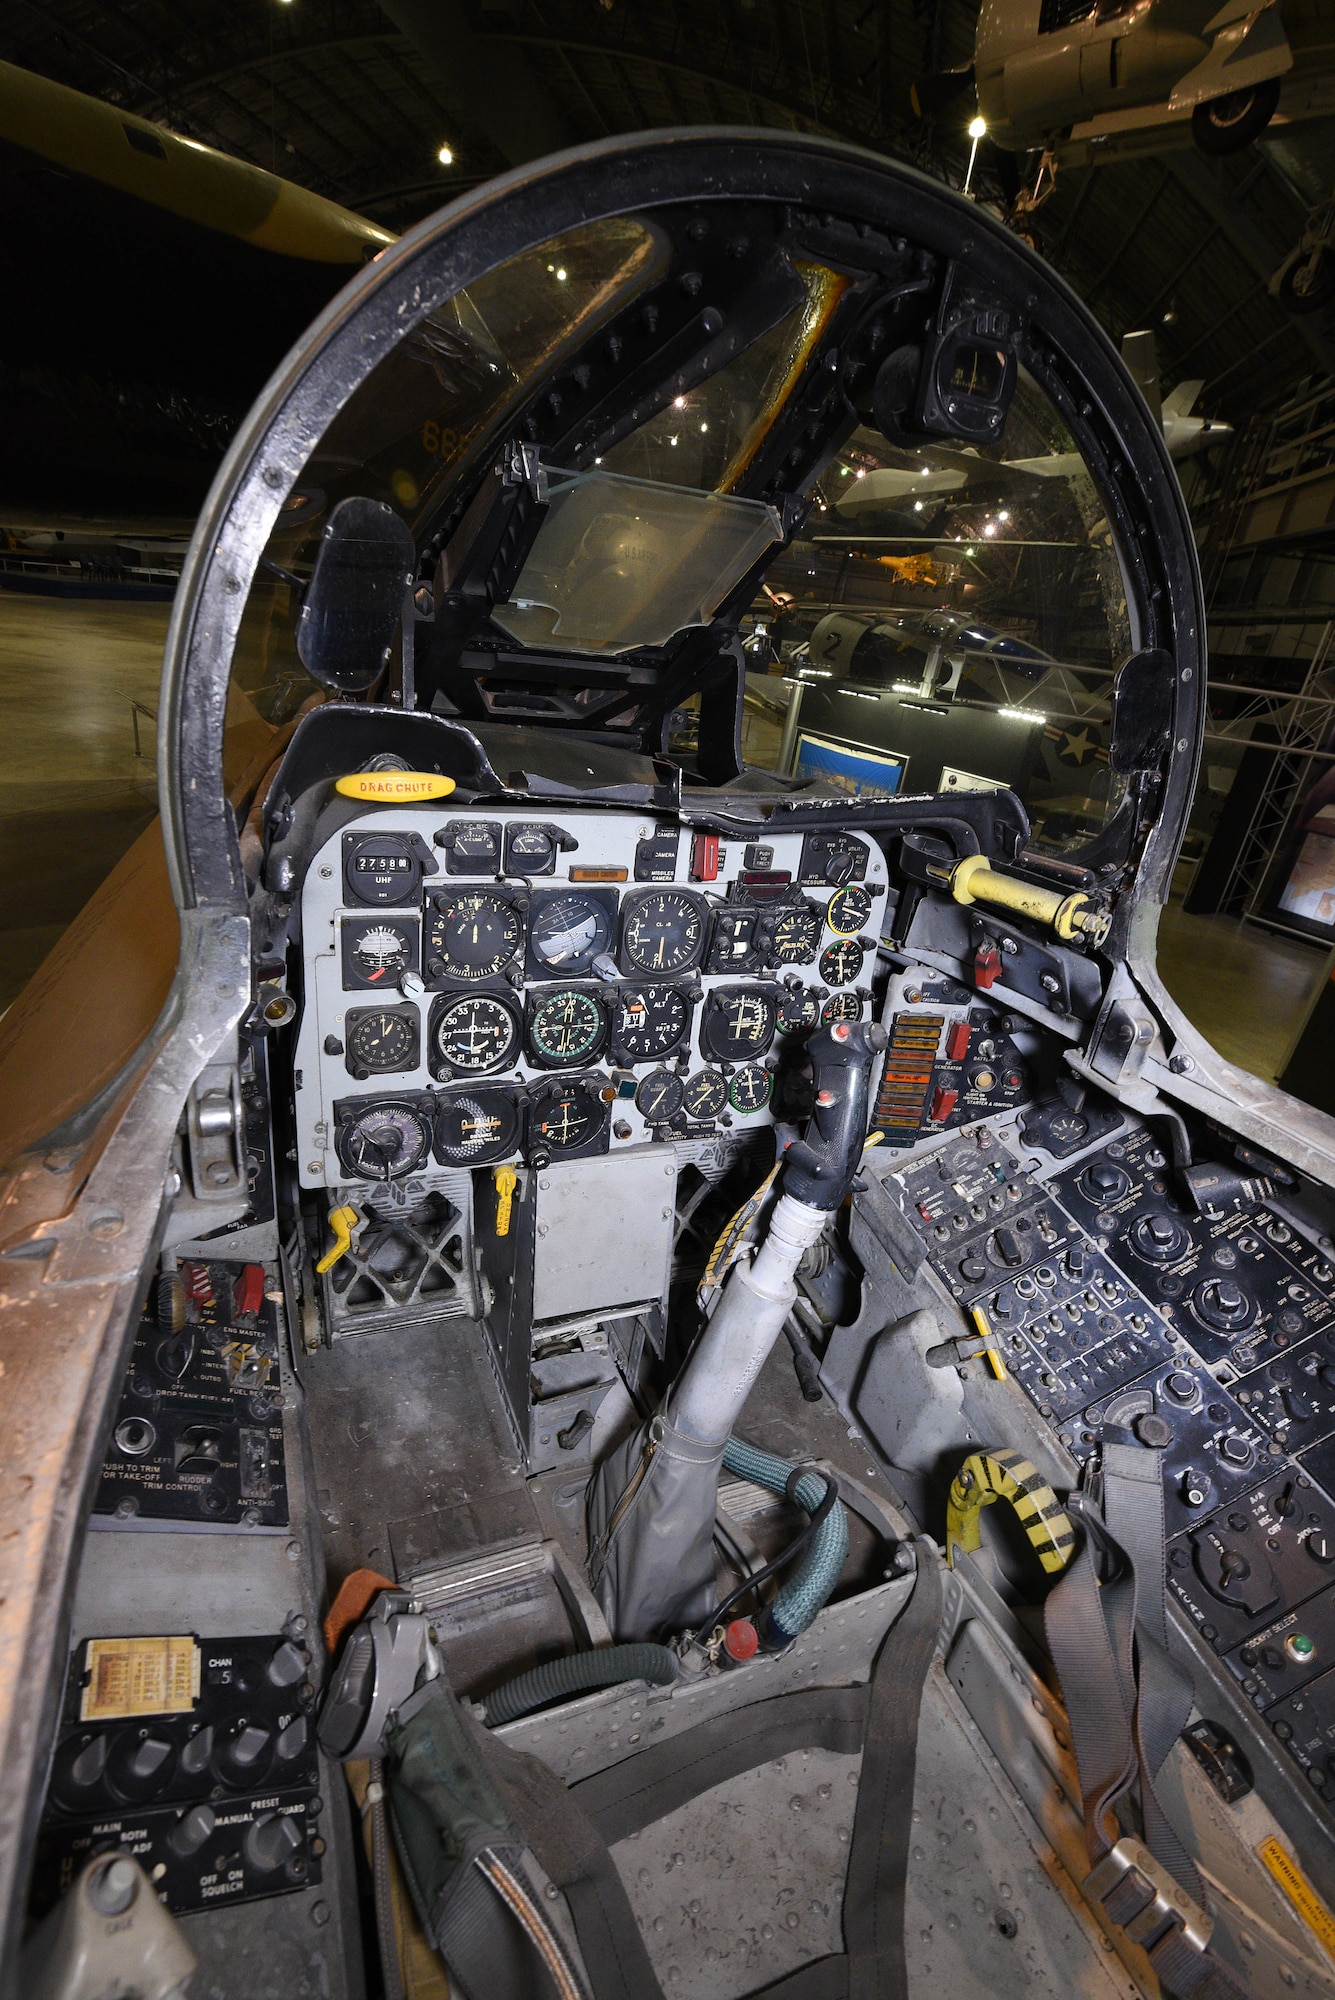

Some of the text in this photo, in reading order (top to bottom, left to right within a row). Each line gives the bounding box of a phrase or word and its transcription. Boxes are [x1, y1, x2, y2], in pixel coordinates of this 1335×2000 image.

[822, 632, 842, 660] 2
[360, 782, 433, 792] DRAG CHUTE
[375, 876, 392, 884] UHF
[458, 901, 464, 909] 8
[658, 903, 665, 912] 2
[447, 909, 453, 918] 7
[678, 909, 684, 917] 4
[438, 921, 445, 929] 6
[686, 929, 691, 937] 6
[443, 953, 450, 962] 4
[494, 955, 500, 963] 2
[654, 953, 659, 962] 2
[650, 990, 655, 998] 0
[557, 999, 565, 1007] 33
[546, 1006, 555, 1015] 30
[672, 1006, 678, 1014] 2
[671, 1023, 677, 1031] 3
[630, 1036, 636, 1044] 6
[659, 1034, 665, 1042] 4
[362, 1161, 378, 1171] ROCKET
[971, 1174, 989, 1187] SUPPLY
[916, 1186, 931, 1197] FLOW
[1128, 1183, 1144, 1194] BRIGHT
[1118, 1202, 1137, 1214] LIGHTS
[1221, 1212, 1242, 1226] QUANTITY
[1257, 1215, 1274, 1226] BRIGHT
[936, 1259, 957, 1285] INTER
[1178, 1264, 1198, 1276] LIGHTS
[1277, 1298, 1287, 1306] OFF
[1303, 1301, 1329, 1318] POSITION
[1313, 1308, 1332, 1322] LIGHTS
[239, 1328, 267, 1338] MASTER
[1227, 1334, 1238, 1342] OFF
[1240, 1327, 1266, 1344] CONSOLE
[1248, 1334, 1268, 1348] LIGHTS
[156, 1389, 177, 1397] DROP
[229, 1388, 247, 1396] FUEL
[153, 1457, 172, 1465] LEFT
[126, 1464, 138, 1472] TO
[140, 1465, 160, 1473] TRIM
[119, 1472, 160, 1480] TAKE-OFF
[179, 1475, 212, 1485] RUDDER
[142, 1481, 203, 1492] TRIM CONTROL
[1250, 1491, 1266, 1504] A/A
[237, 1499, 276, 1507] ANTI-SKID
[1252, 1505, 1267, 1516] T/R
[1258, 1515, 1273, 1527] REC
[1268, 1523, 1282, 1535] OFF
[1170, 1578, 1206, 1620] TACAN
[1245, 1612, 1298, 1648] COCKPIT SELECT
[208, 1658, 233, 1668] CHAN
[220, 1671, 232, 1685] 5
[250, 1797, 280, 1810] PRESET
[277, 1804, 305, 1815] GUARD
[214, 1812, 254, 1826] MANUAL
[93, 1822, 122, 1835] MAIN
[120, 1830, 148, 1842] BOTH
[131, 1842, 153, 1854] ADF
[1269, 1846, 1300, 1889] WARNING
[200, 1870, 244, 1887] OFF ON
[200, 1880, 244, 1898] SQUELCH
